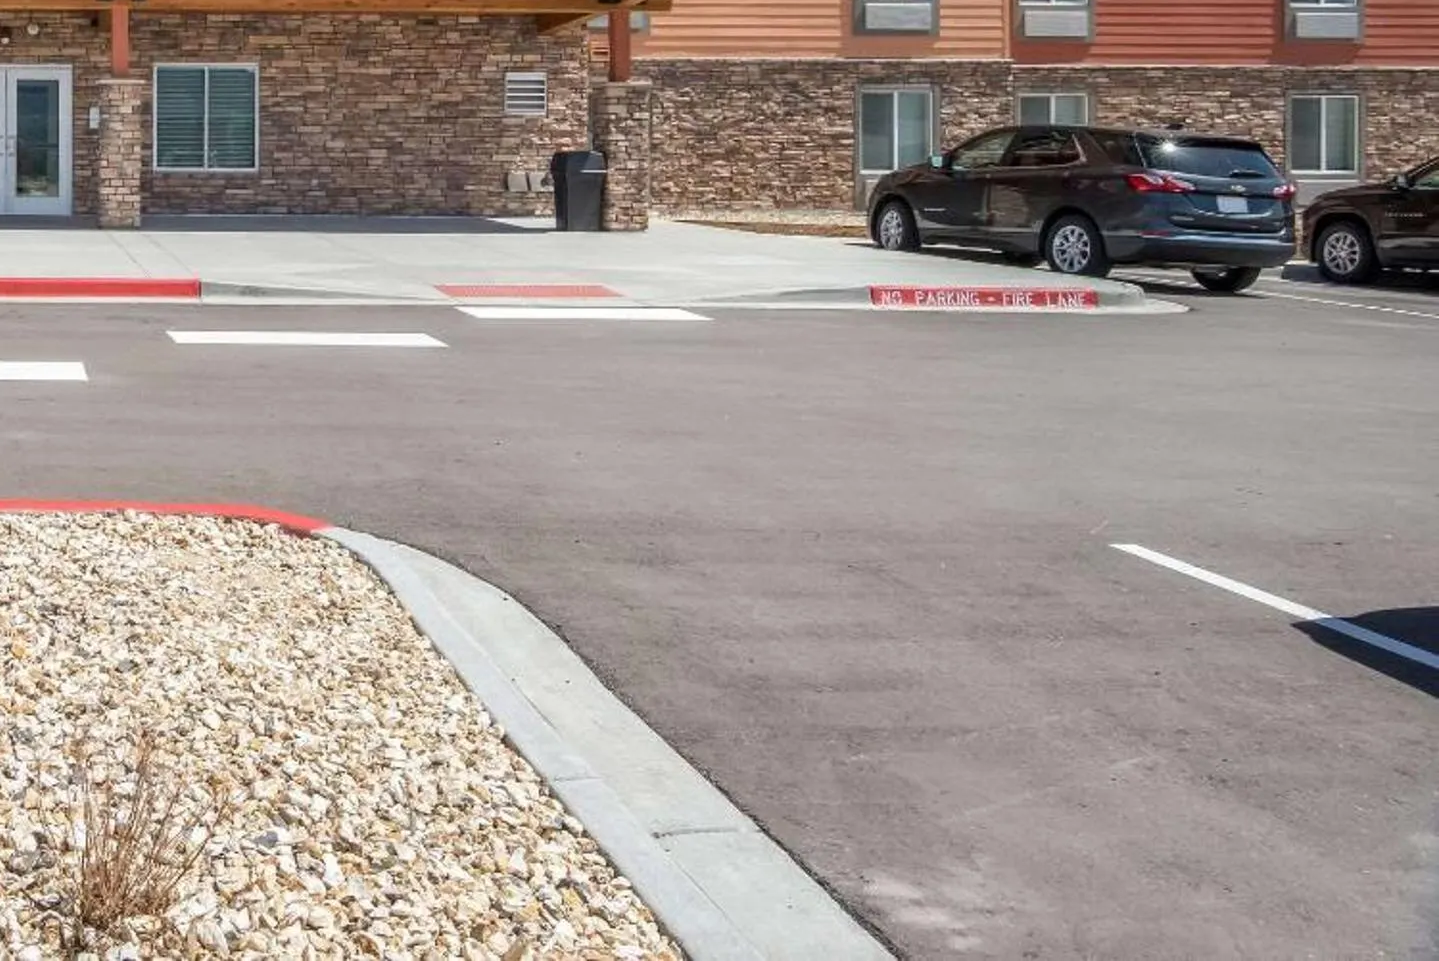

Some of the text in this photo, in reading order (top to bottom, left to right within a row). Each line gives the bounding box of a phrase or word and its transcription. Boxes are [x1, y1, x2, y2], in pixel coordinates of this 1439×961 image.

[881, 290, 902, 306] NO
[914, 291, 980, 307] PARKING
[1002, 292, 1035, 308] FIRE
[1045, 292, 1087, 309] LANE
